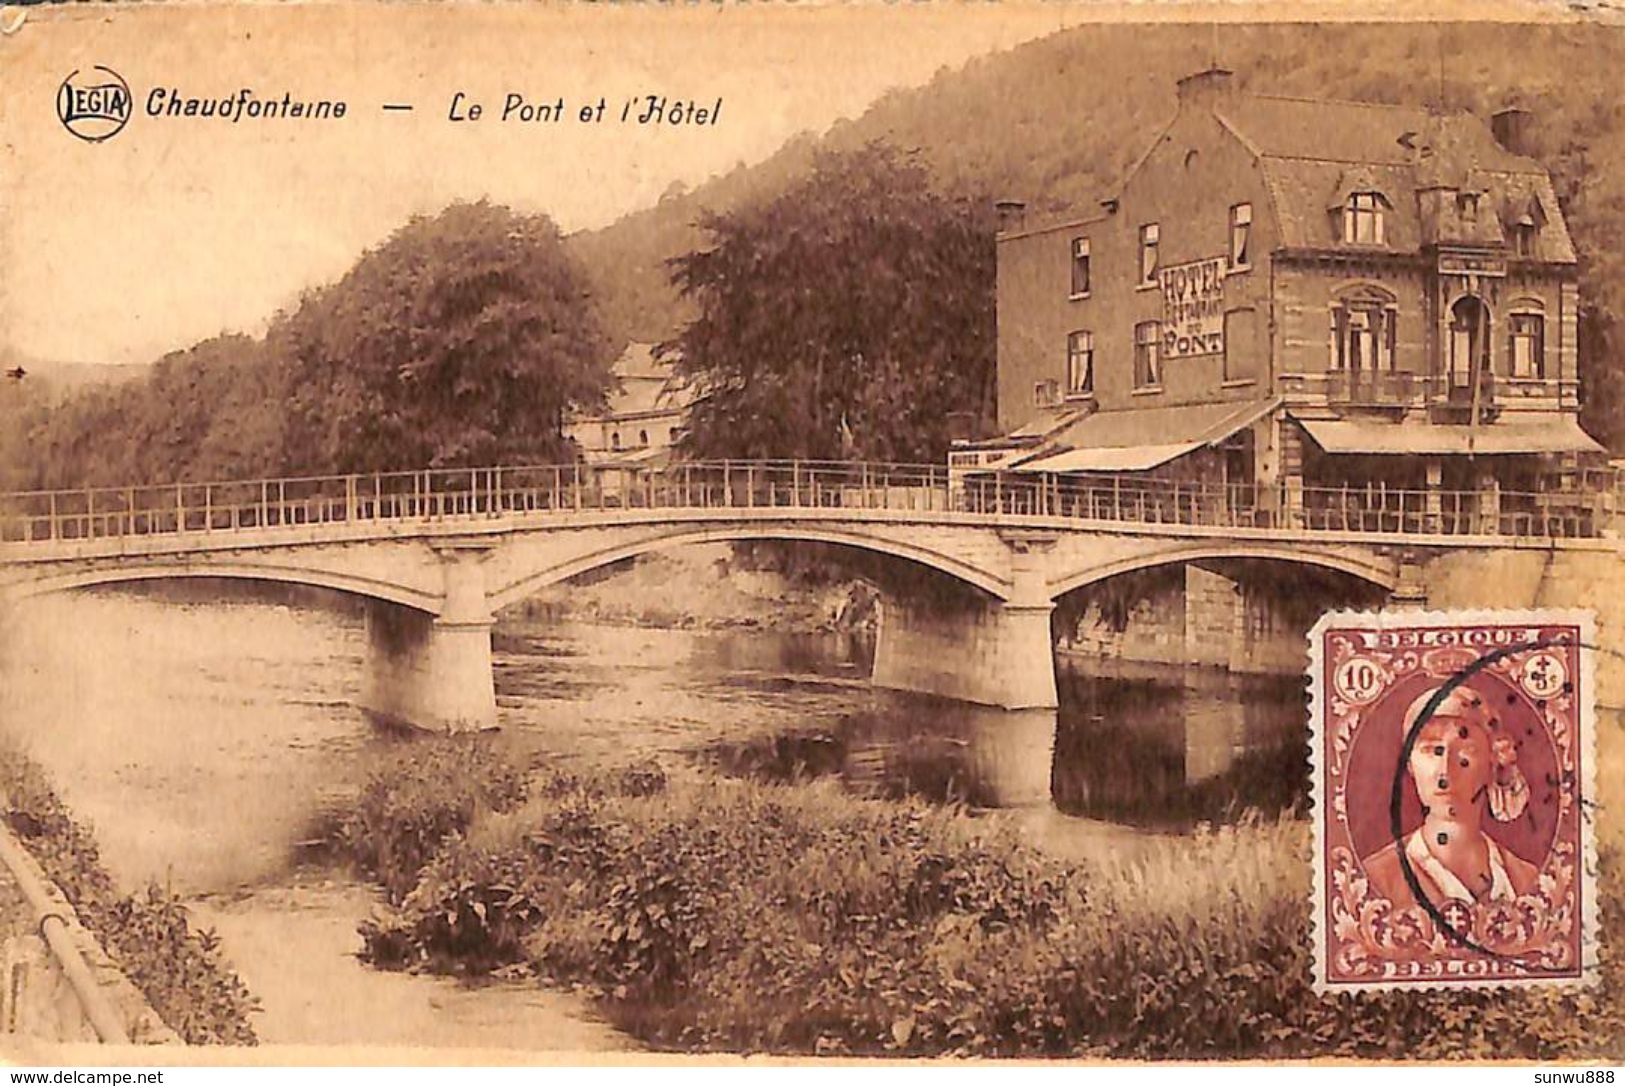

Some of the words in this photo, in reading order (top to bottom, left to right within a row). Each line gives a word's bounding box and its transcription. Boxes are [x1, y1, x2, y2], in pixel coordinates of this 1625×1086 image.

[64, 83, 127, 123] LEGIA
[146, 87, 347, 122] Chaudfontaine
[449, 92, 482, 122] Le
[502, 92, 563, 122] Pont
[579, 97, 606, 123] et
[621, 95, 722, 125] l'Hôtel
[1164, 262, 1222, 301] HOTEL
[1164, 331, 1221, 355] PONT
[1378, 629, 1528, 648] BELGIQUE
[1345, 664, 1375, 691] 10
